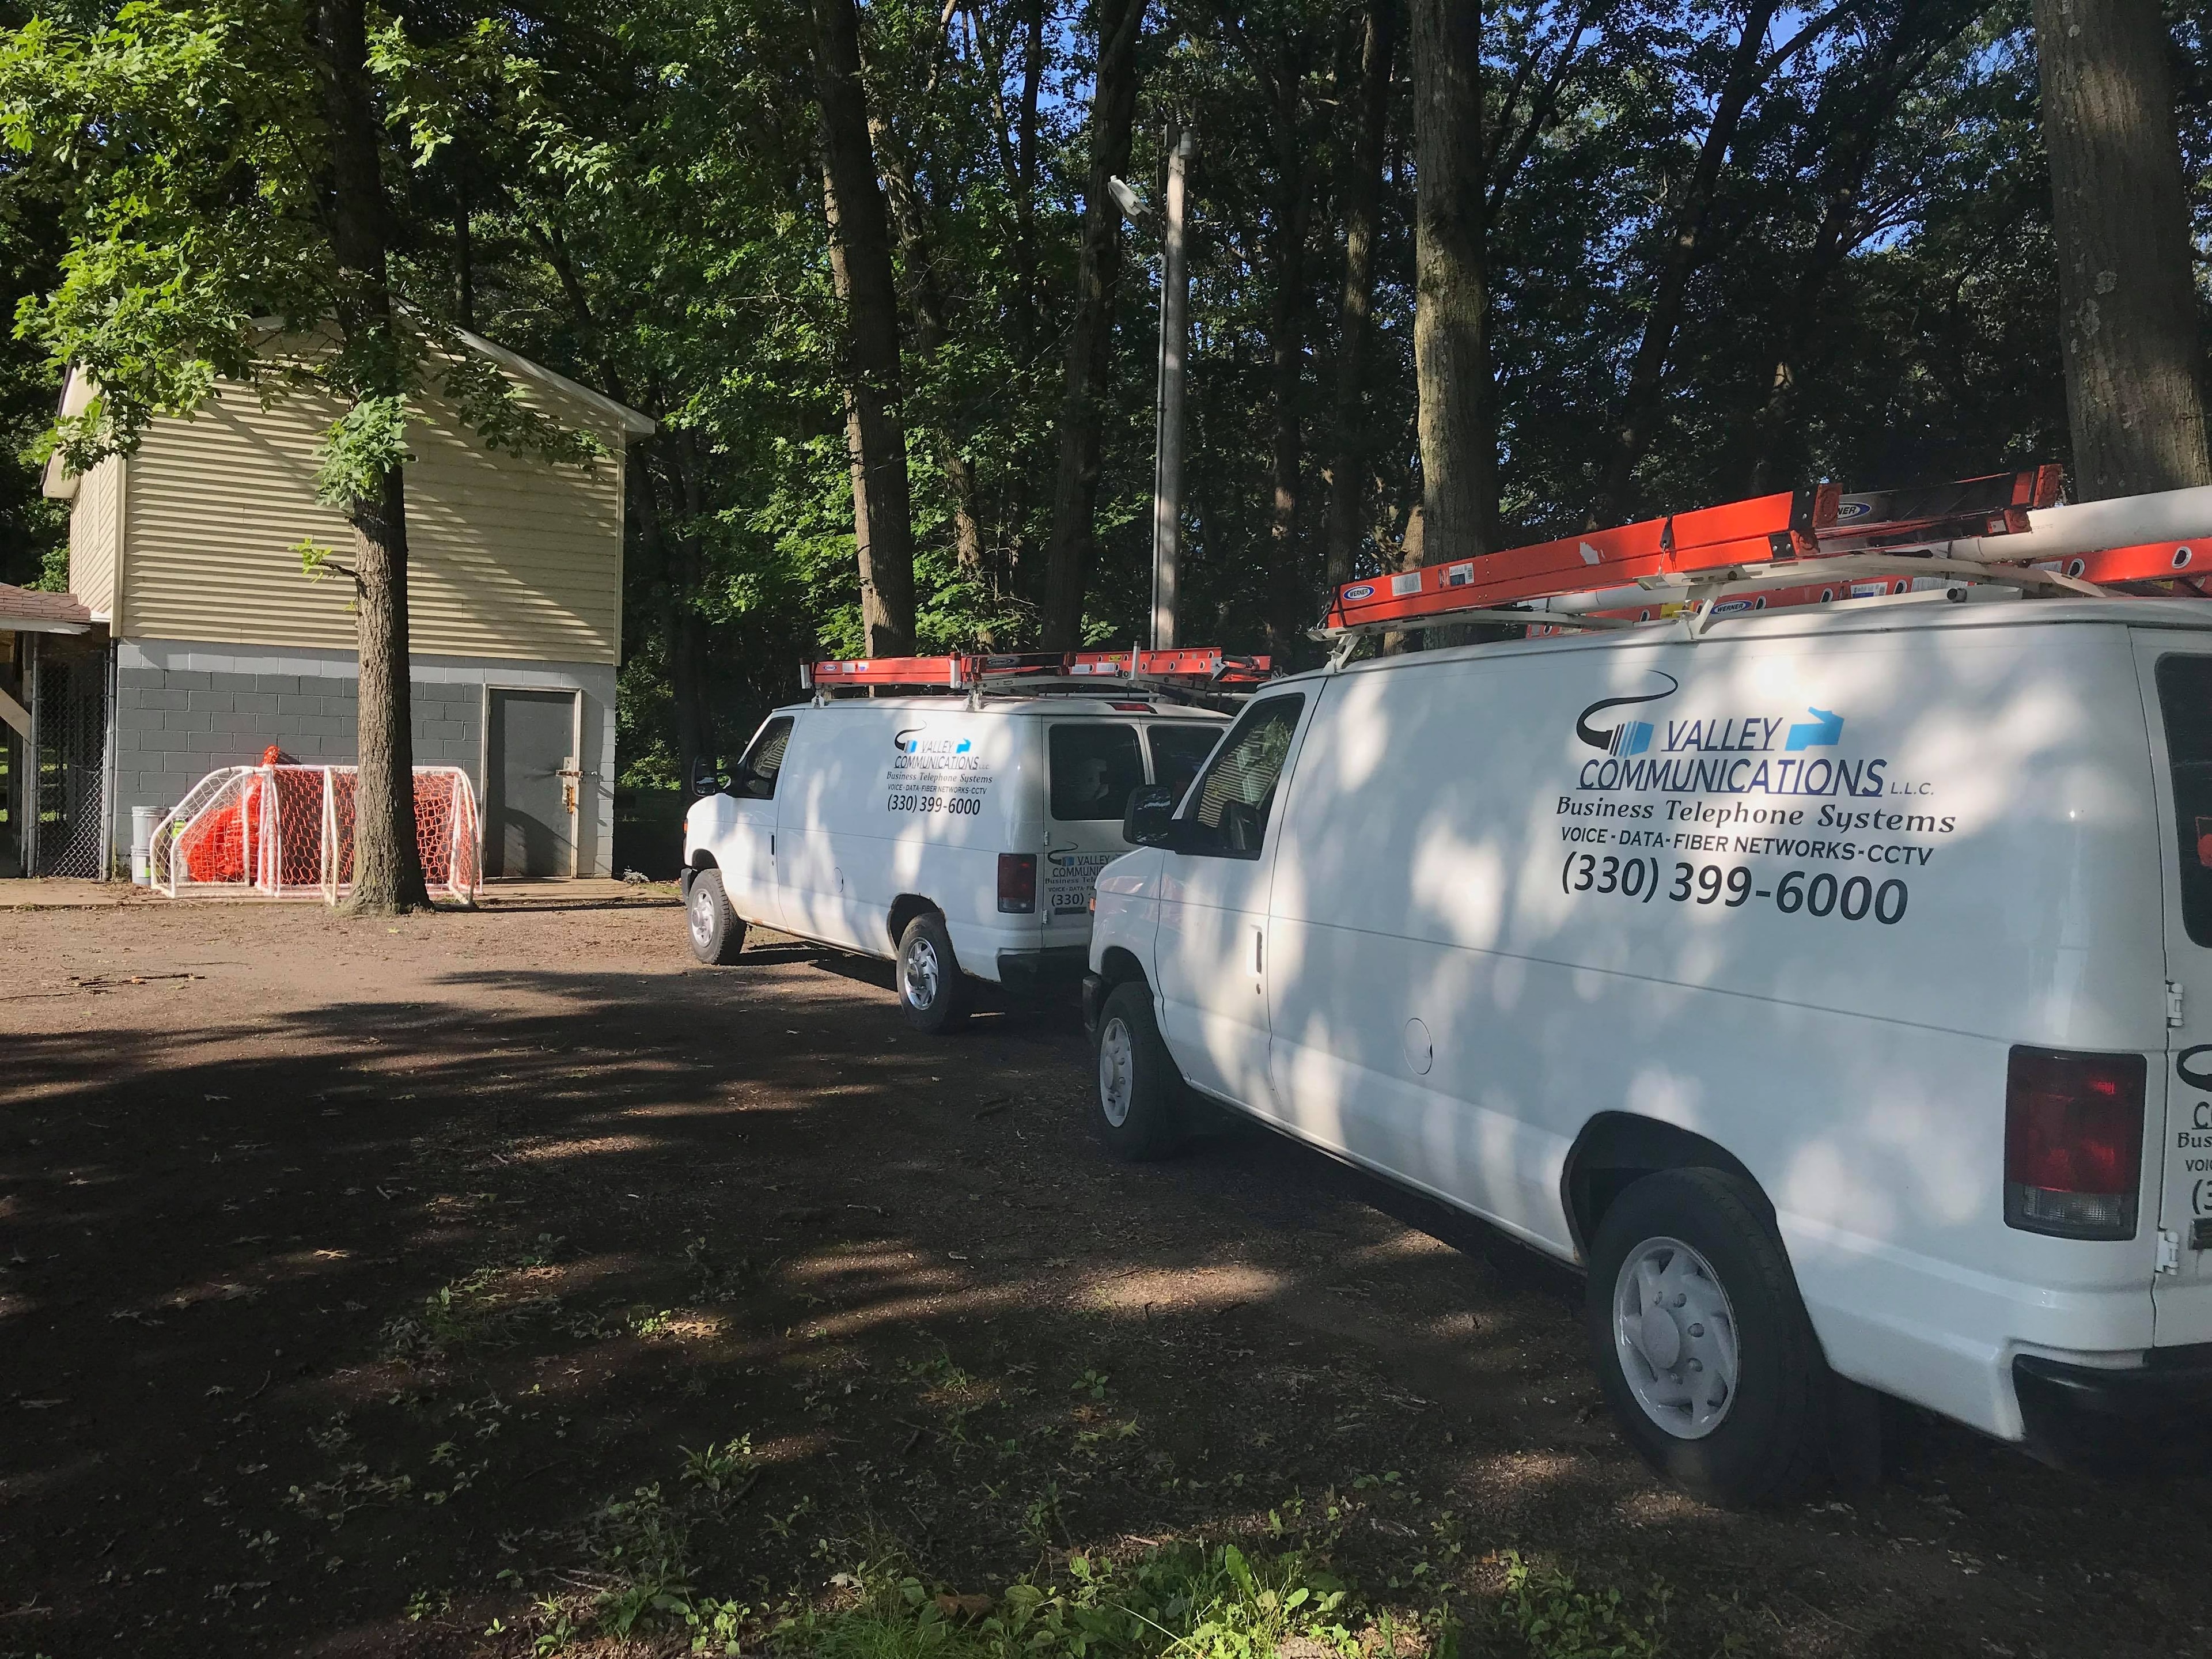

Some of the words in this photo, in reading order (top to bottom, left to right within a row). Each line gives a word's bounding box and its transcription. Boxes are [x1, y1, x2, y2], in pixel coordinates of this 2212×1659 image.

[1717, 603, 1743, 612] WERNER
[1661, 717, 1784, 752] VALLEY
[921, 740, 955, 753] VALLEY
[894, 755, 979, 770] COMMUNICATIONS
[887, 771, 916, 780] Business
[920, 772, 957, 783] Telephone
[960, 774, 993, 783] Systems
[1576, 759, 1888, 798] COMMUNICATIONS
[887, 793, 918, 813] (330)
[919, 796, 981, 816] 399-6000
[1556, 796, 1654, 819] Business
[1665, 800, 1804, 828] Telephone
[1817, 804, 1957, 834] Systems
[1077, 855, 1110, 865] VALLEY
[1562, 851, 1660, 903] (330)
[1669, 862, 1908, 925] 399-6000
[1051, 892, 1084, 907] (330)
